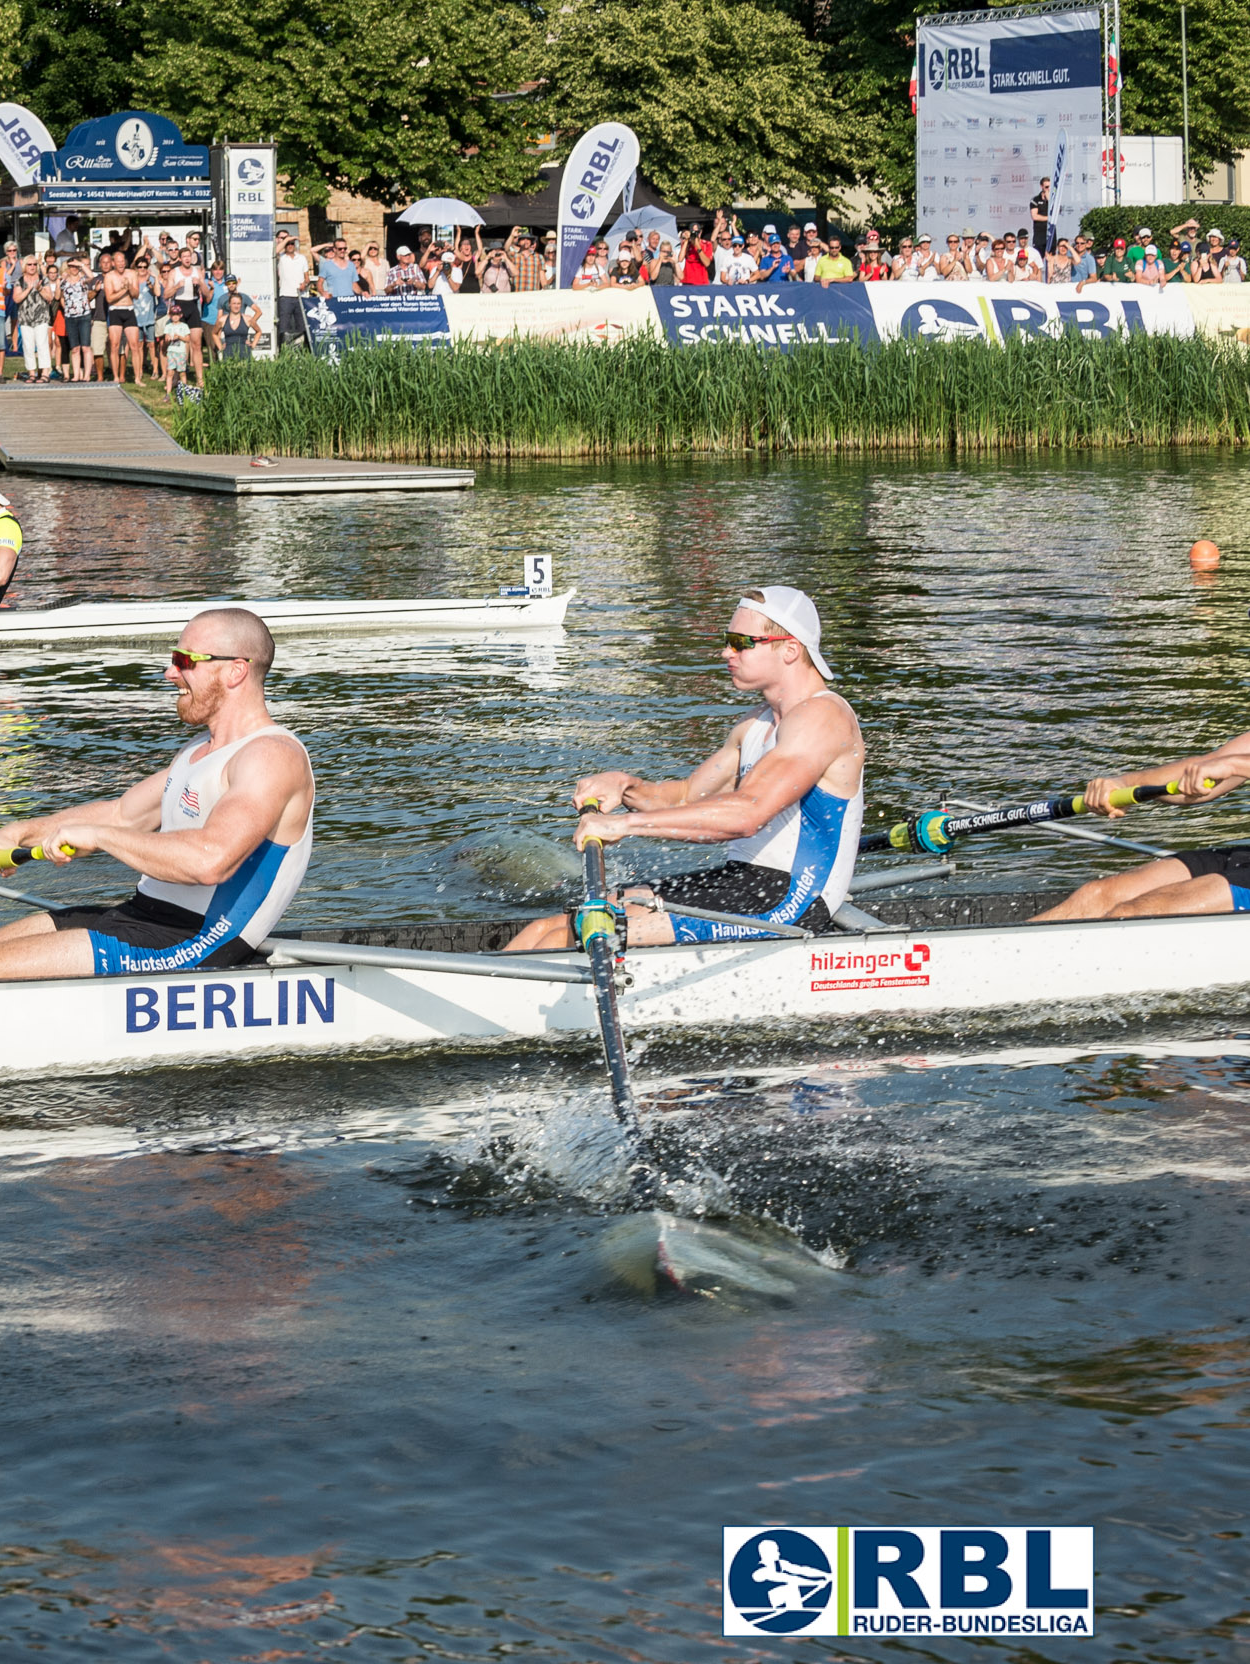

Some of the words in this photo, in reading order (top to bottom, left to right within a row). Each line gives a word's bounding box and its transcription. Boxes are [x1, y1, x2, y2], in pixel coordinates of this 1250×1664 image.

[948, 47, 985, 80] RBL
[992, 72, 1017, 88] STARK.
[1017, 70, 1052, 86] SCHNELL.
[1053, 68, 1070, 83] GUT.
[580, 137, 620, 192] RBL
[238, 193, 265, 202] RBL
[670, 294, 796, 318] STARK.
[678, 322, 850, 345] SCHNELL.
[533, 558, 545, 584] 5
[1030, 802, 1050, 816] RBL
[947, 816, 973, 832] STARK.
[972, 811, 1007, 828] SCHNELL.
[811, 952, 901, 974] hilzinger
[813, 980, 859, 990] Deutschlands
[859, 979, 879, 989] große
[880, 976, 928, 986] Fenstermarke.
[126, 978, 335, 1033] BERLIN
